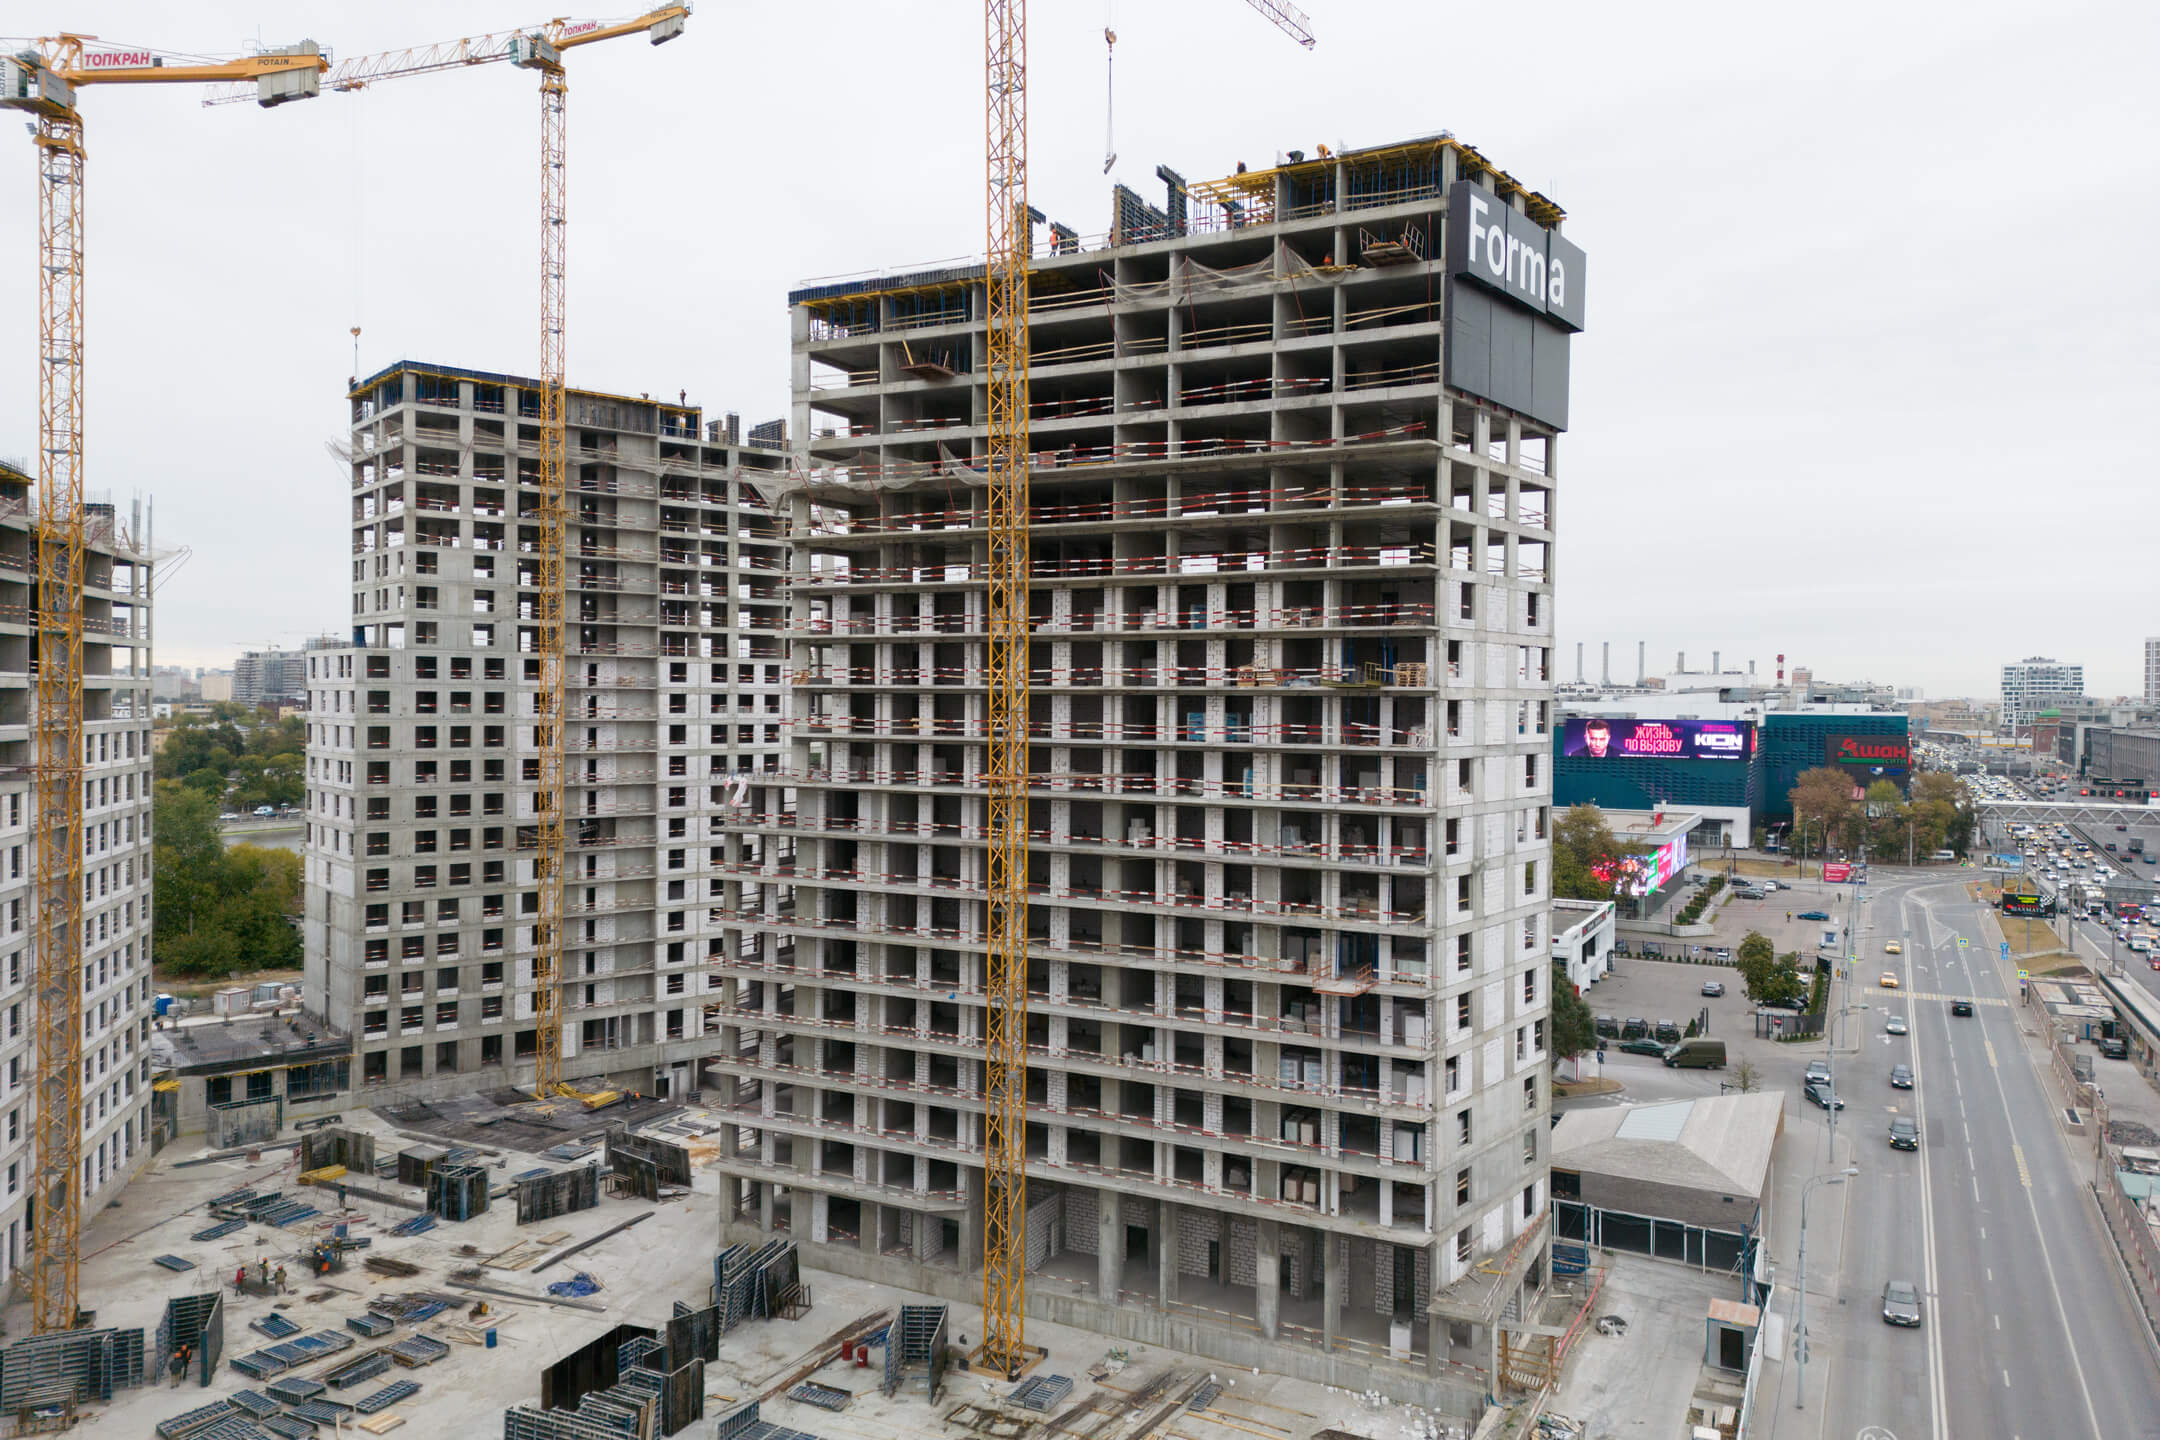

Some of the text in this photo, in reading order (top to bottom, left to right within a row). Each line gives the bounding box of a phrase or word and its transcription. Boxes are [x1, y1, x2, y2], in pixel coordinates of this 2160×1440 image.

[563, 21, 597, 36] ТОПКРАН
[84, 52, 150, 66] ТОПКРАН
[257, 58, 290, 66] POTAIN
[1468, 193, 1565, 308] Forma
[1634, 724, 1673, 741] ЖИЗНЬ
[1624, 738, 1683, 754] ПО ВЫЗОВУ
